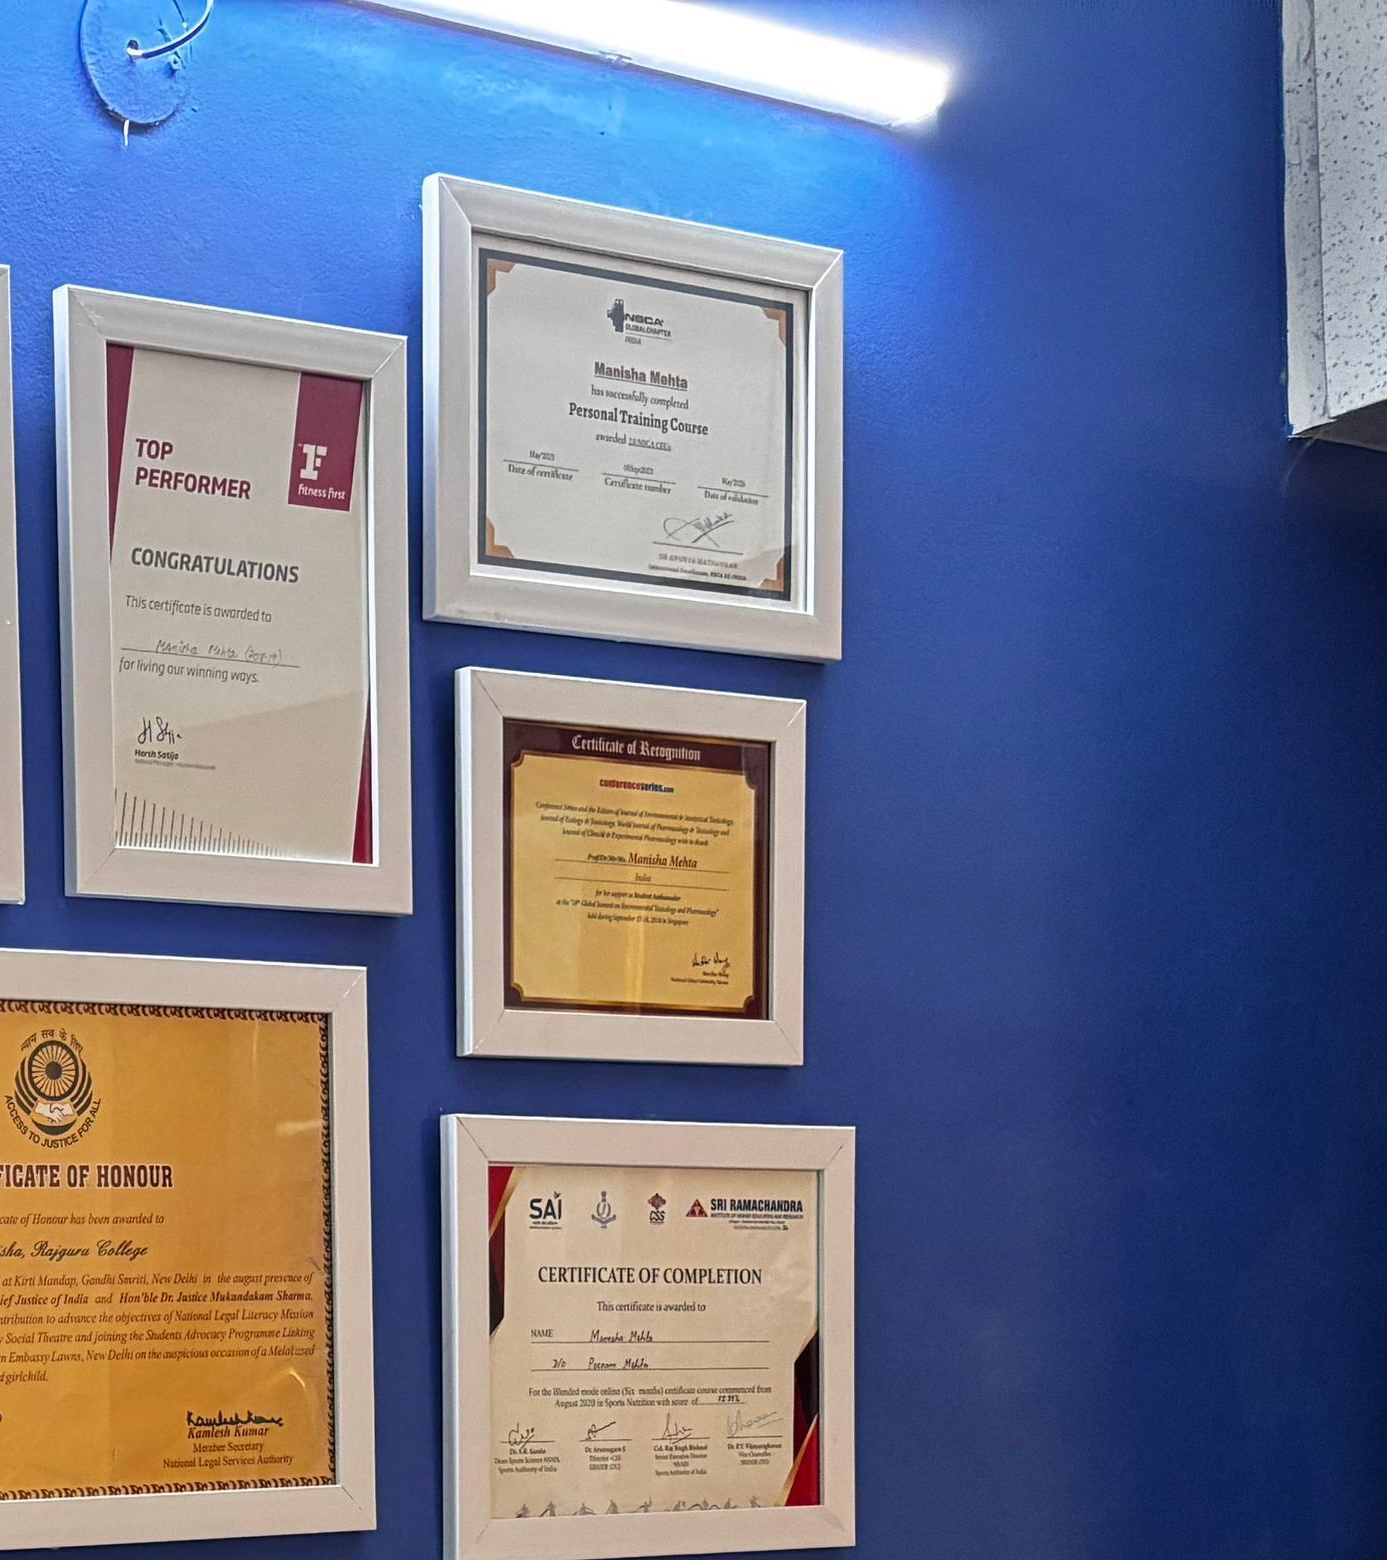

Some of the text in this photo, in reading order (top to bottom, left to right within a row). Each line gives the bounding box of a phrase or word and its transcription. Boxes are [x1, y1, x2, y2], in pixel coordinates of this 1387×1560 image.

[595, 362, 687, 388] Manisha Mehta
[591, 384, 688, 410] has successfully completed
[569, 402, 708, 435] Personal Training Course
[136, 439, 173, 460] TOP
[136, 467, 250, 499] PERFORMER
[132, 548, 298, 583] CONGRATULATIONS
[126, 595, 272, 622] This certificate is awarded to
[119, 657, 259, 684] for living our winning ways.
[572, 735, 700, 760] Certificate of Recognition
[628, 852, 698, 868] Manisha Mehta
[4, 1095, 101, 1148] ACCESS TO JUSTICE FOR ALL
[65, 1165, 92, 1187] OF
[94, 1165, 172, 1187] HONOUR
[711, 1199, 802, 1212] SRI RAMACHANDRA
[20, 1214, 32, 1227] of
[32, 1214, 68, 1224] Honour
[70, 1213, 86, 1224] has
[88, 1213, 110, 1224] been
[111, 1212, 154, 1224] awarded
[155, 1216, 164, 1224] to
[97, 1240, 148, 1261] College
[538, 1267, 761, 1284] CERTIFICATE OF COMPLETION
[596, 1301, 614, 1311] This
[615, 1301, 654, 1311] certificate
[664, 1301, 695, 1311] awarded
[531, 1329, 553, 1337] NAME
[188, 1426, 269, 1438] Kamlesh Kumar
